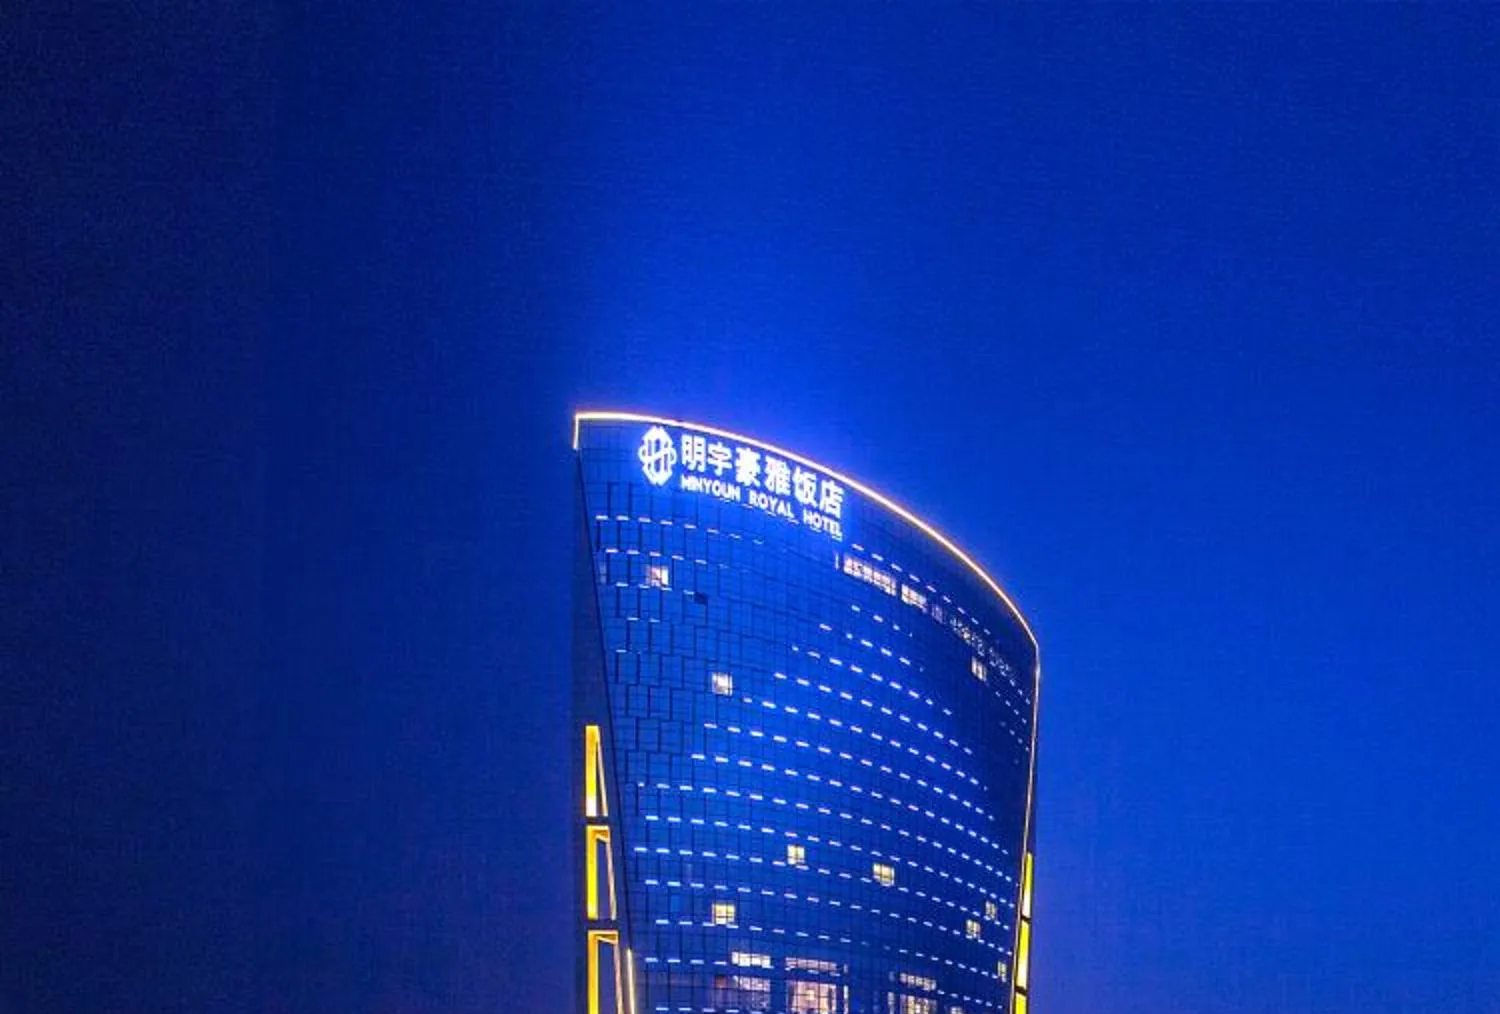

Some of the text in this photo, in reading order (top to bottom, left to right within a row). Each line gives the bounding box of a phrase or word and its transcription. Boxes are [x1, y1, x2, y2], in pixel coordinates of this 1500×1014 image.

[681, 434, 844, 518] 明宇豪雅饭店
[681, 474, 843, 538] MINYOUN ROYAL HOTEL
